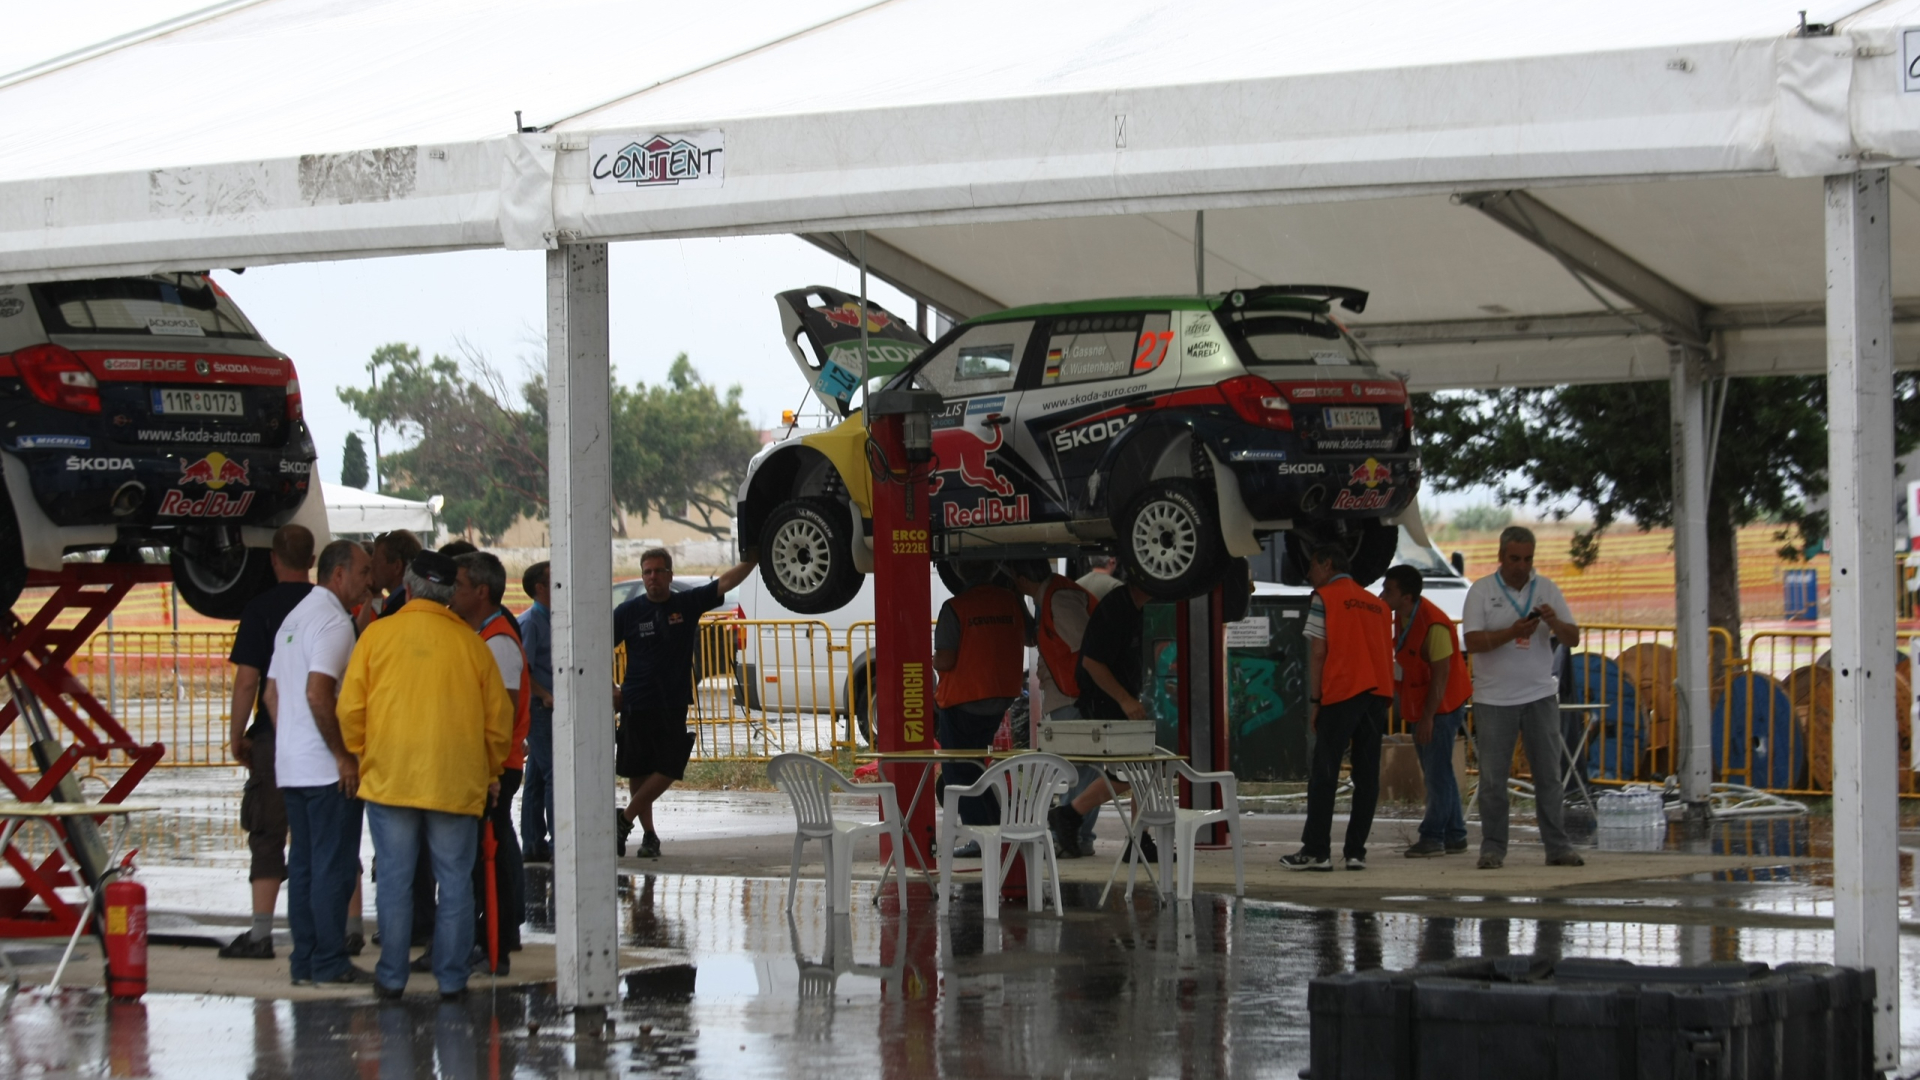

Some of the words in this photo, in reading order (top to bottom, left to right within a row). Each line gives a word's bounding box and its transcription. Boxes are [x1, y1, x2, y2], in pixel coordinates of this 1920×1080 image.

[593, 148, 723, 179] CONTENT
[1073, 345, 1107, 357] Gassner
[1133, 331, 1174, 370] 27
[142, 360, 187, 371] EDGE
[213, 361, 250, 373] ŠKODA
[166, 392, 193, 411] 11R
[203, 393, 237, 412] 0173
[1042, 383, 1148, 411] www.skoda-auto.com
[36, 437, 87, 446] MICHELIN
[138, 428, 261, 444] www.skoda-auto.com
[1317, 436, 1393, 450] www.skoda-auto.com
[65, 455, 135, 471] ŠKODA
[1278, 462, 1326, 475] ŠKODA
[892, 529, 928, 541] ERCO
[892, 542, 928, 554] 3222EL
[902, 662, 924, 719] CORGHI
